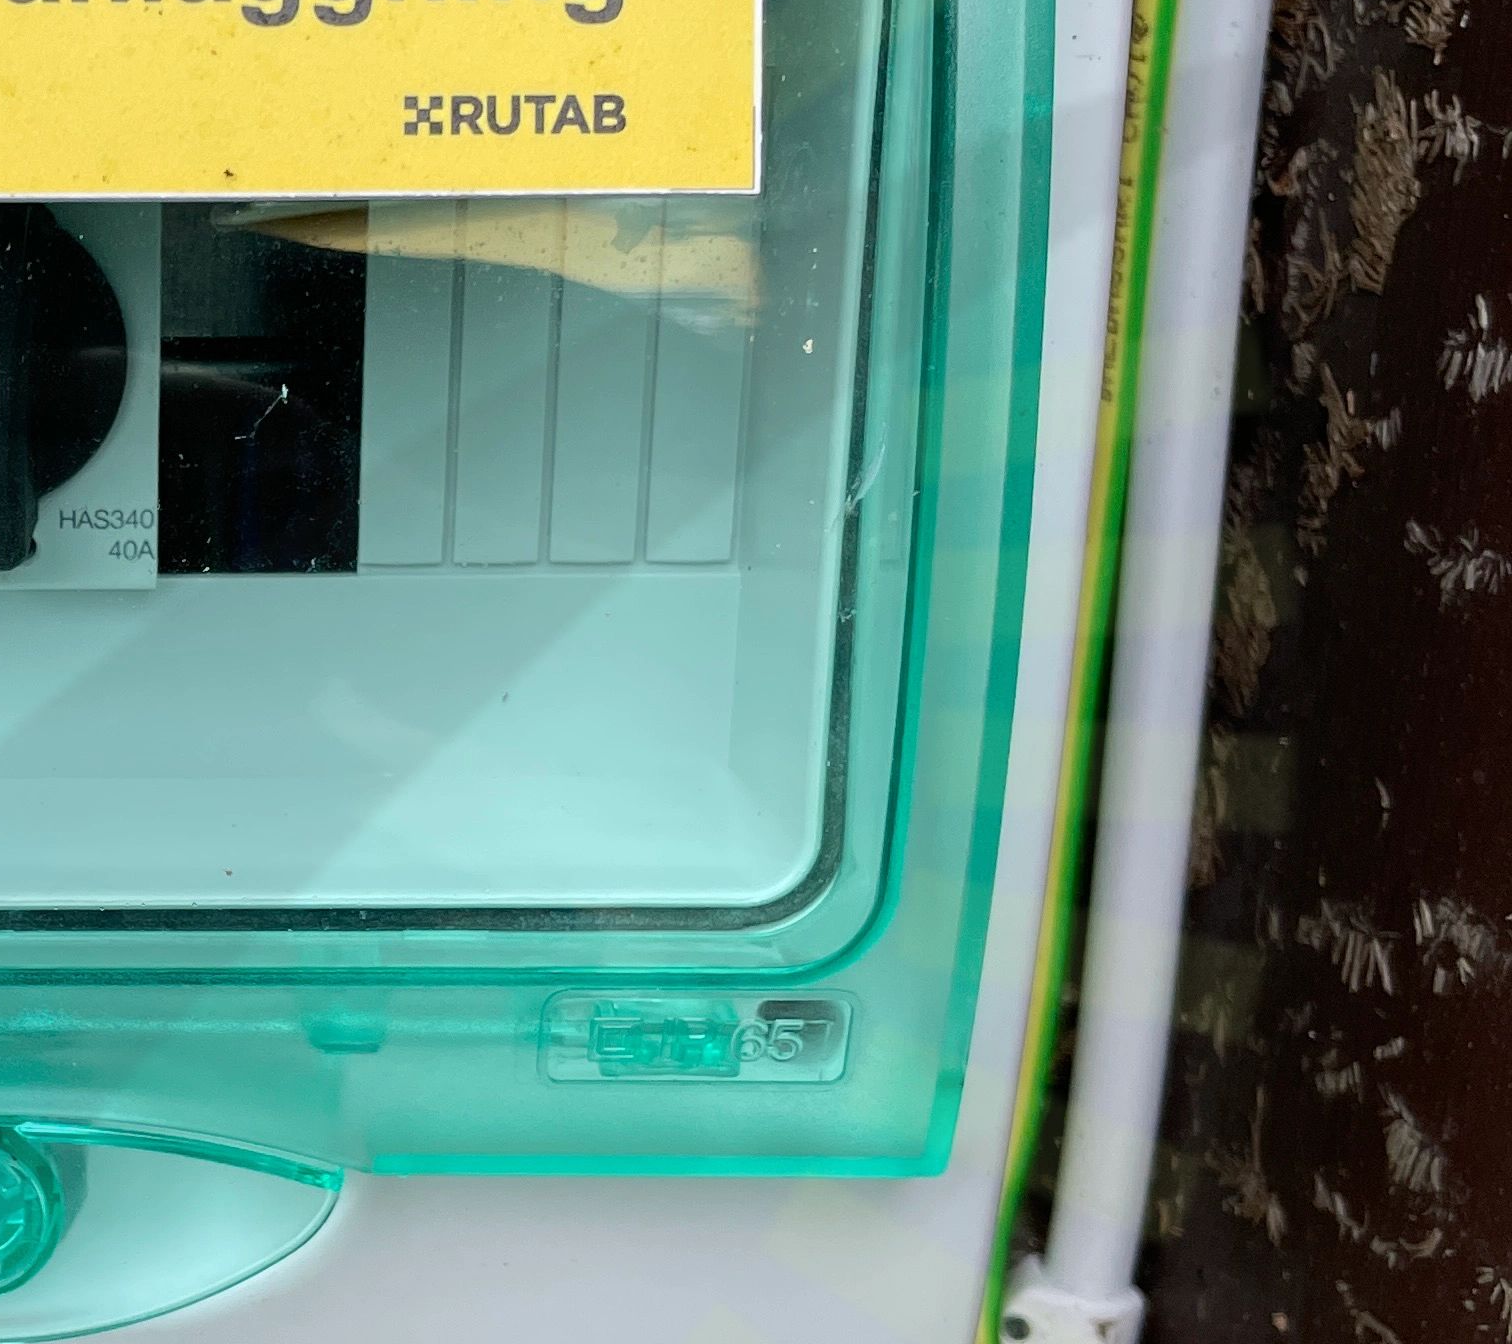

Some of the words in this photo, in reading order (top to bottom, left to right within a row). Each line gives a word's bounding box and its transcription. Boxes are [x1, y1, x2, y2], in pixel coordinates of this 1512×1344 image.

[450, 94, 627, 136] RUTAB
[59, 508, 155, 530] HAS340
[108, 539, 156, 561] 40A
